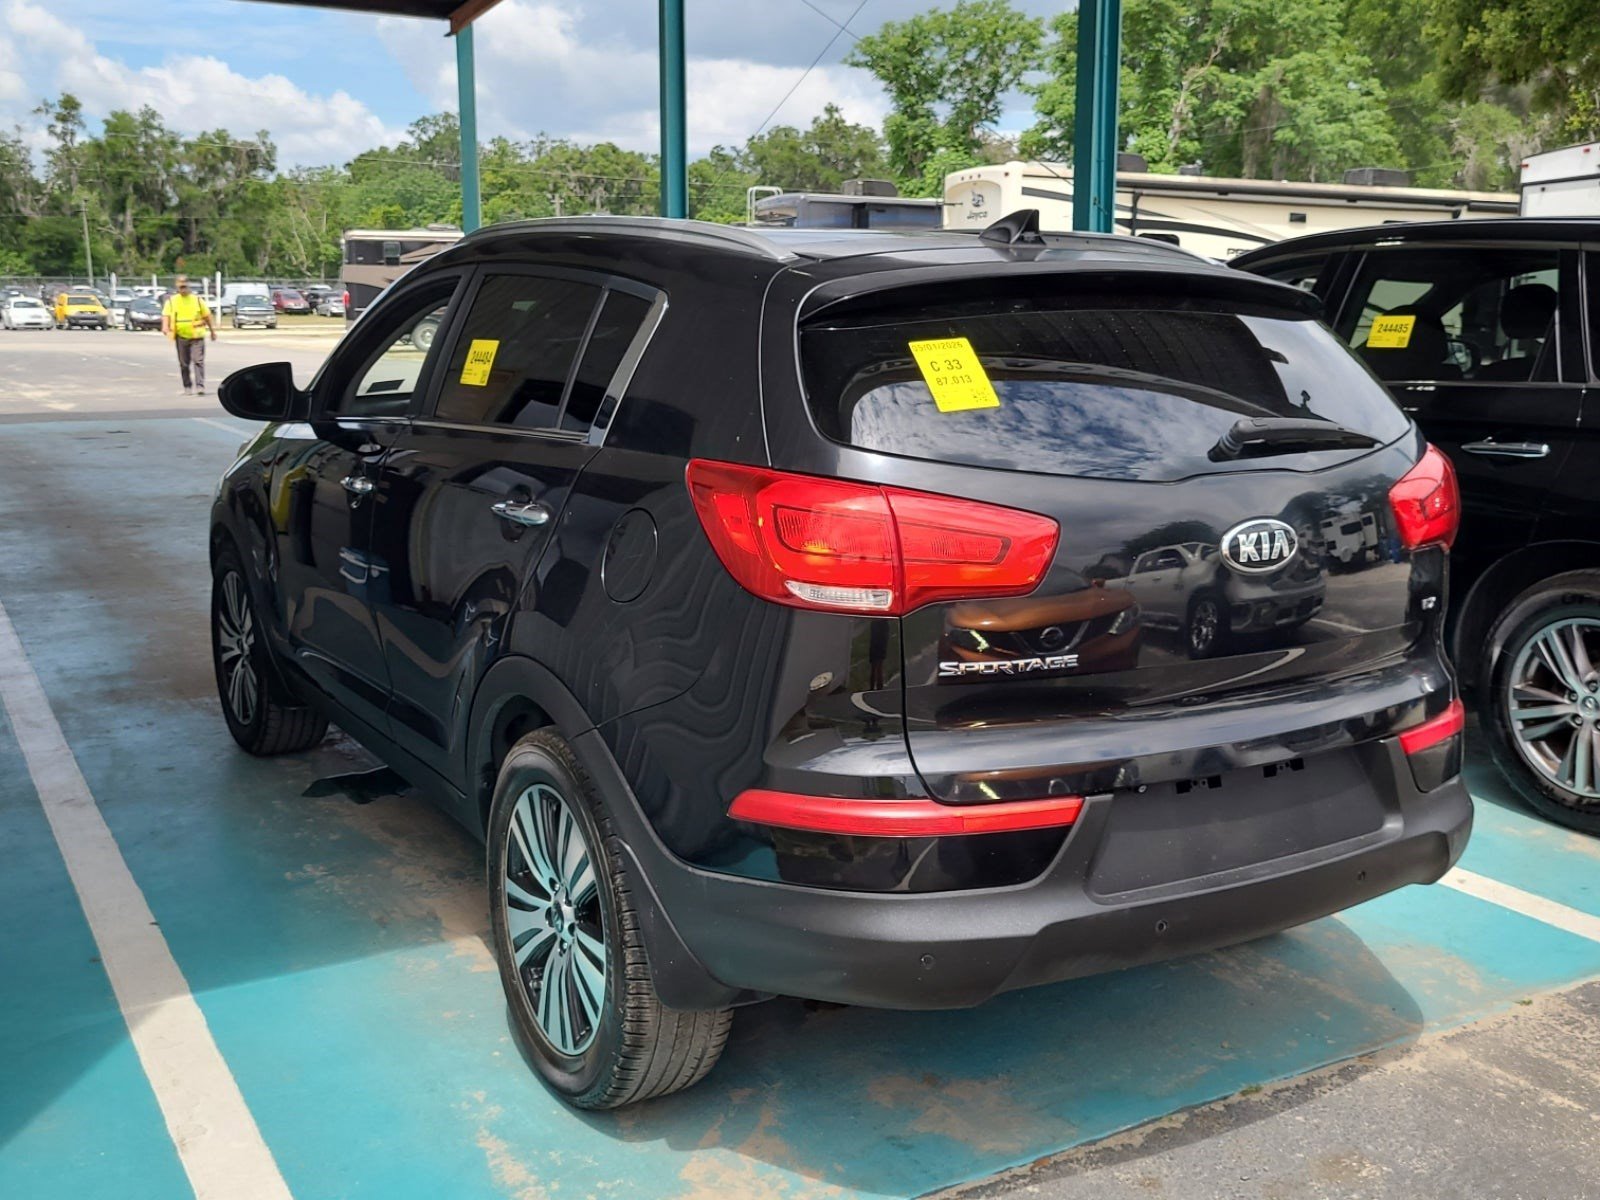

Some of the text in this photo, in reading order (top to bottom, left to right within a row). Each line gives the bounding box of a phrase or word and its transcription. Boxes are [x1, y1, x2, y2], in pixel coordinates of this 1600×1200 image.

[966, 210, 988, 221] Jayco
[1377, 323, 1410, 333] 244485
[930, 359, 962, 372] C 33
[1236, 529, 1290, 563] KIA
[938, 654, 1080, 677] SPORTAGE
